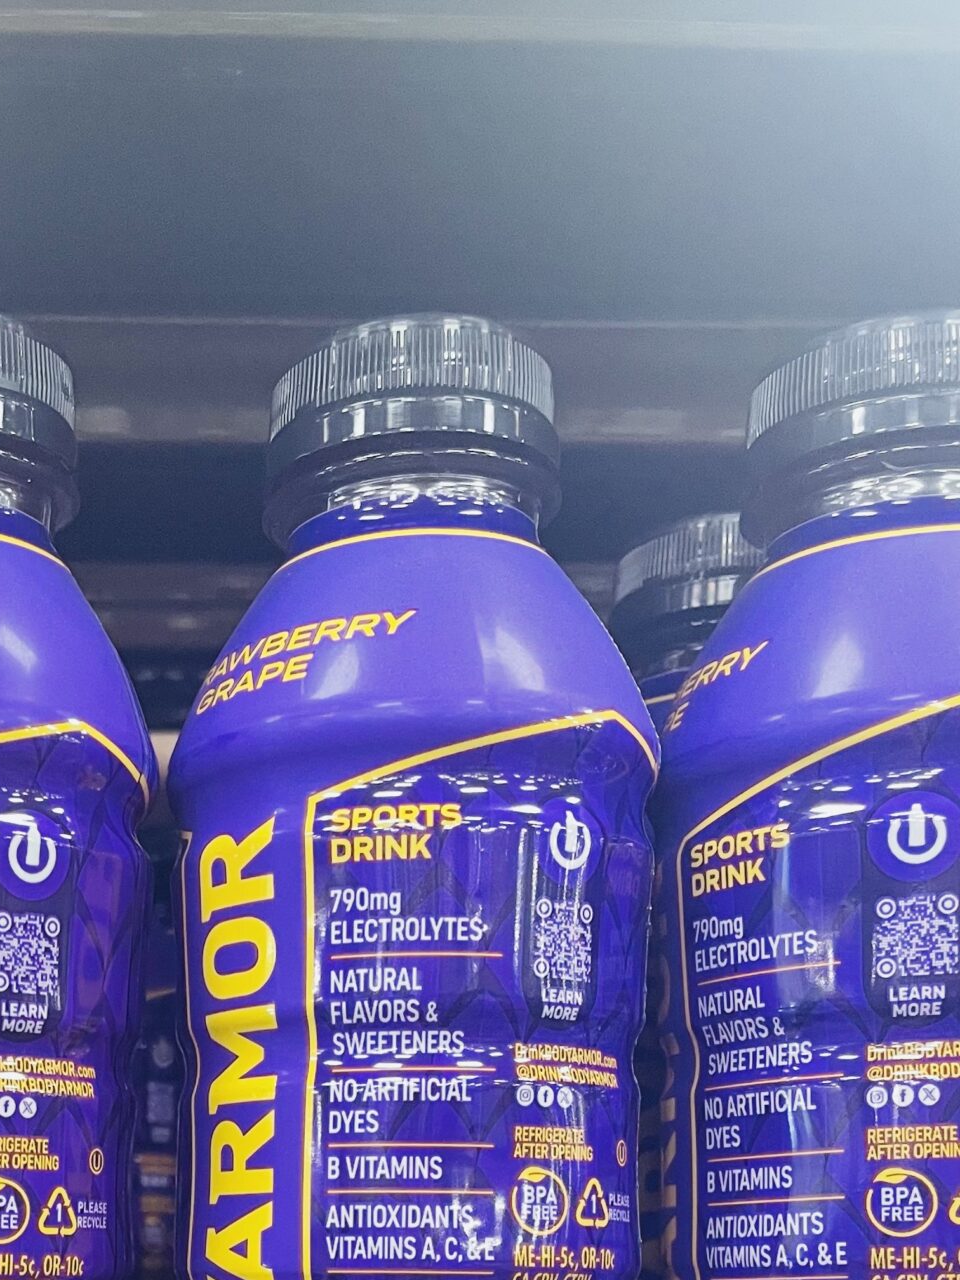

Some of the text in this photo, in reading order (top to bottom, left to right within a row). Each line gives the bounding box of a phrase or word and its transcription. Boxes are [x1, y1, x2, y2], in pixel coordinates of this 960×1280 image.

[196, 653, 313, 715] GRAPE
[331, 804, 462, 832] SPORTS
[331, 833, 432, 864] DRINK
[690, 822, 790, 869] SPORTS
[692, 858, 766, 897] DRINK
[330, 887, 401, 915] 790mg
[330, 917, 483, 945] ELECTROLYTES
[693, 916, 744, 944] 790mg
[695, 928, 817, 973] ELECTROLYTES
[330, 967, 422, 993] NATURAL
[888, 984, 946, 1002] LEARN
[1, 1002, 48, 1019] LEARN
[541, 988, 583, 1005] LEARN
[698, 985, 765, 1020] NATURAL
[892, 1002, 942, 1018] MORE
[1, 1019, 44, 1034] MORE
[542, 1005, 579, 1021] MORE
[704, 1018, 768, 1047] FLAVORS
[708, 1041, 813, 1076] SWEETENERS
[727, 1087, 816, 1117] ARTIFICIAL
[328, 1110, 379, 1134] DYES
[706, 1126, 740, 1150] DYES
[12, 1156, 60, 1171] OPENING
[77, 1201, 107, 1214] PLEASE
[326, 1204, 473, 1230] ANTIOXIDANTS
[77, 1216, 107, 1229] RECYCLE
[707, 1212, 824, 1240] ANTIOXIDANTS
